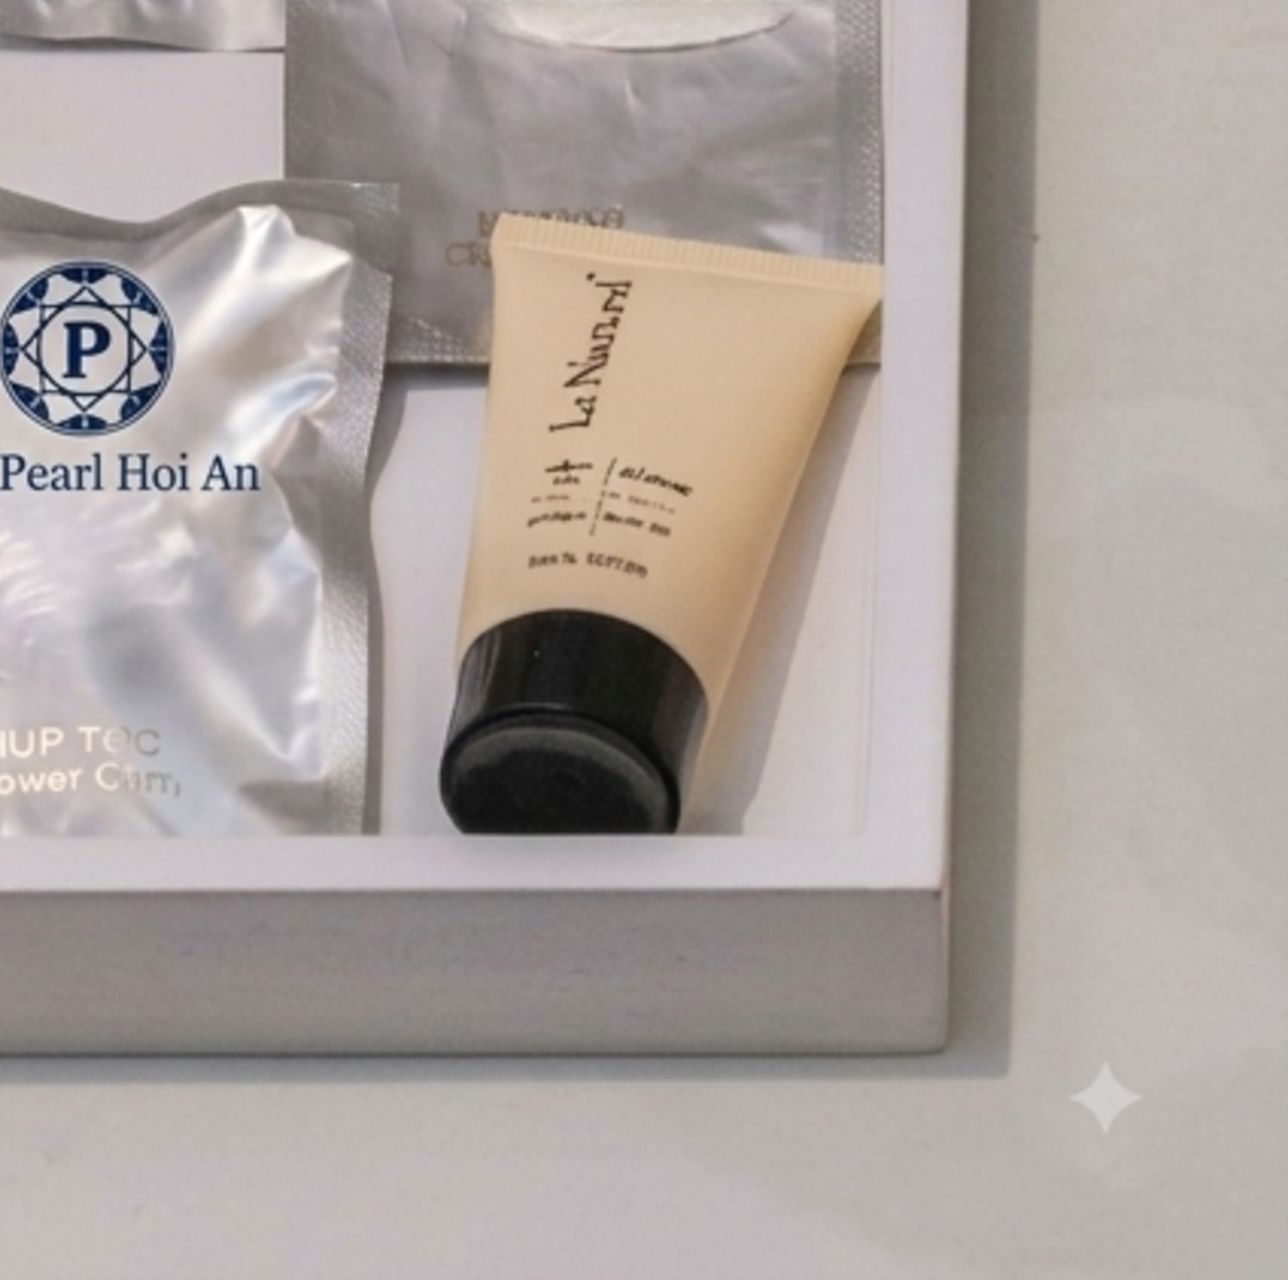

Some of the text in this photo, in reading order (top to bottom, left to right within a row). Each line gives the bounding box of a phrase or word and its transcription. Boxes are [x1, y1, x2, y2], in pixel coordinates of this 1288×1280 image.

[61, 319, 113, 380] P
[116, 451, 191, 492] Hoi
[200, 454, 261, 492] An
